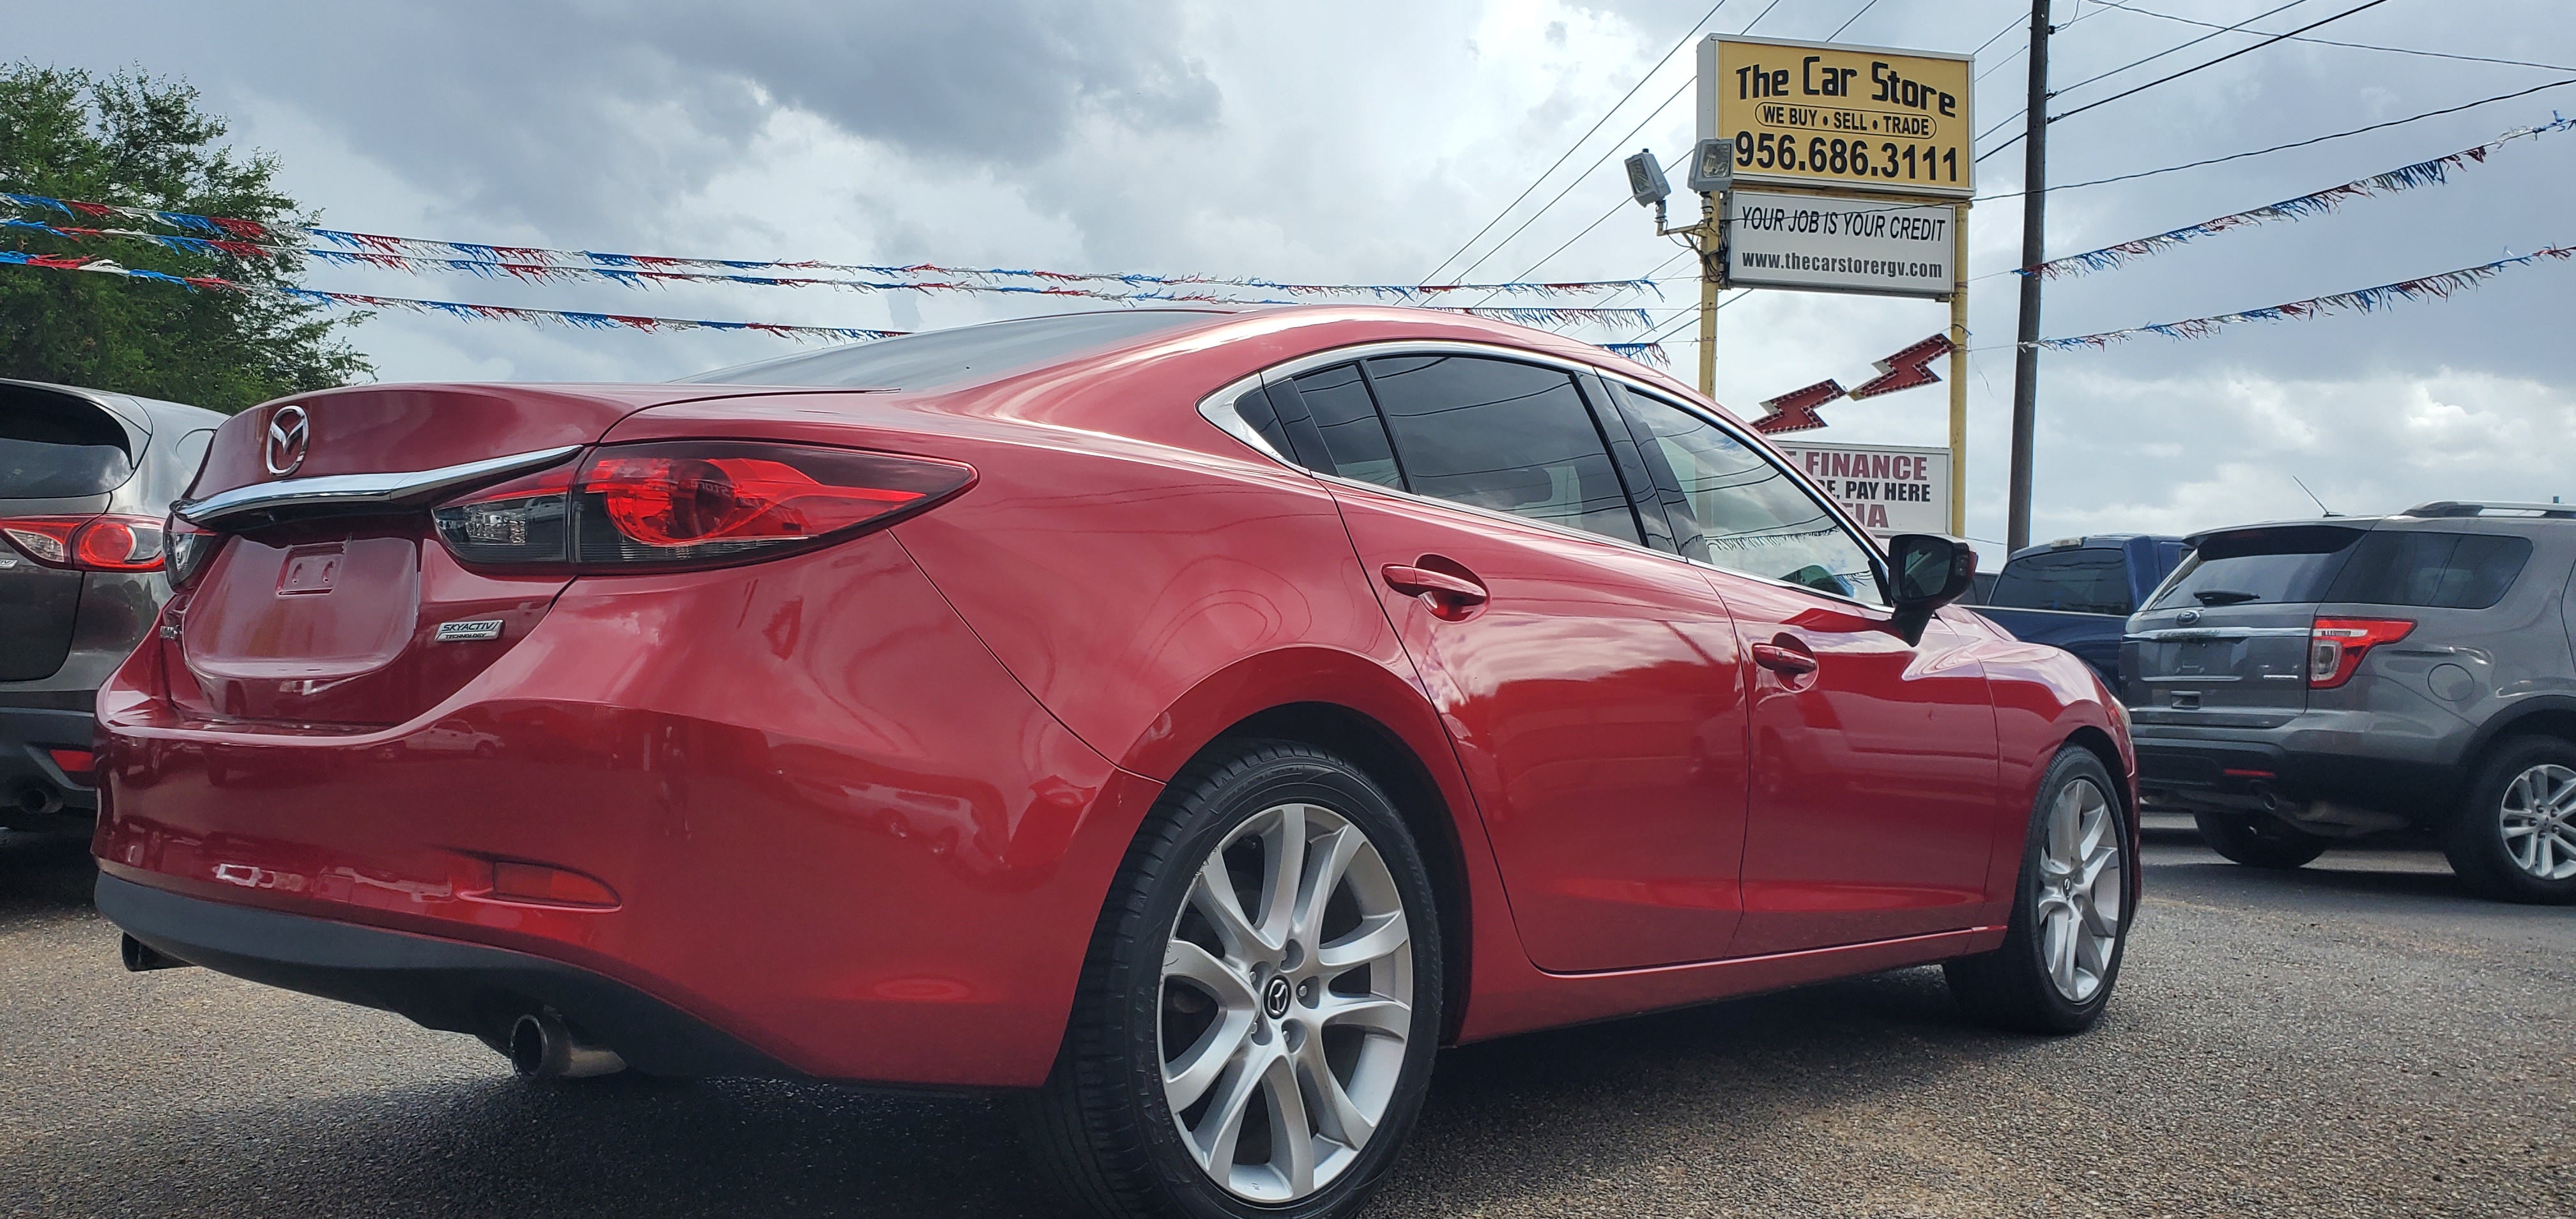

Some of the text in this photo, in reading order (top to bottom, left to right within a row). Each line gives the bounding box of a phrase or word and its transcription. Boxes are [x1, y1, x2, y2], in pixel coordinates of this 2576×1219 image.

[1736, 56, 1956, 118] The Car Store
[1763, 105, 1929, 135] WE BUY SELL TRADE
[1735, 130, 1957, 182] 956.686.3111
[1742, 206, 1946, 242] YOUR JOB IS YOUR CREDIT
[1742, 252, 1942, 279] www.thecarstorergv.com
[1805, 451, 1928, 480] FINANCE
[1845, 481, 1880, 500] PAY
[1884, 482, 1931, 502] HERE
[441, 622, 495, 631] SKYACTIV
